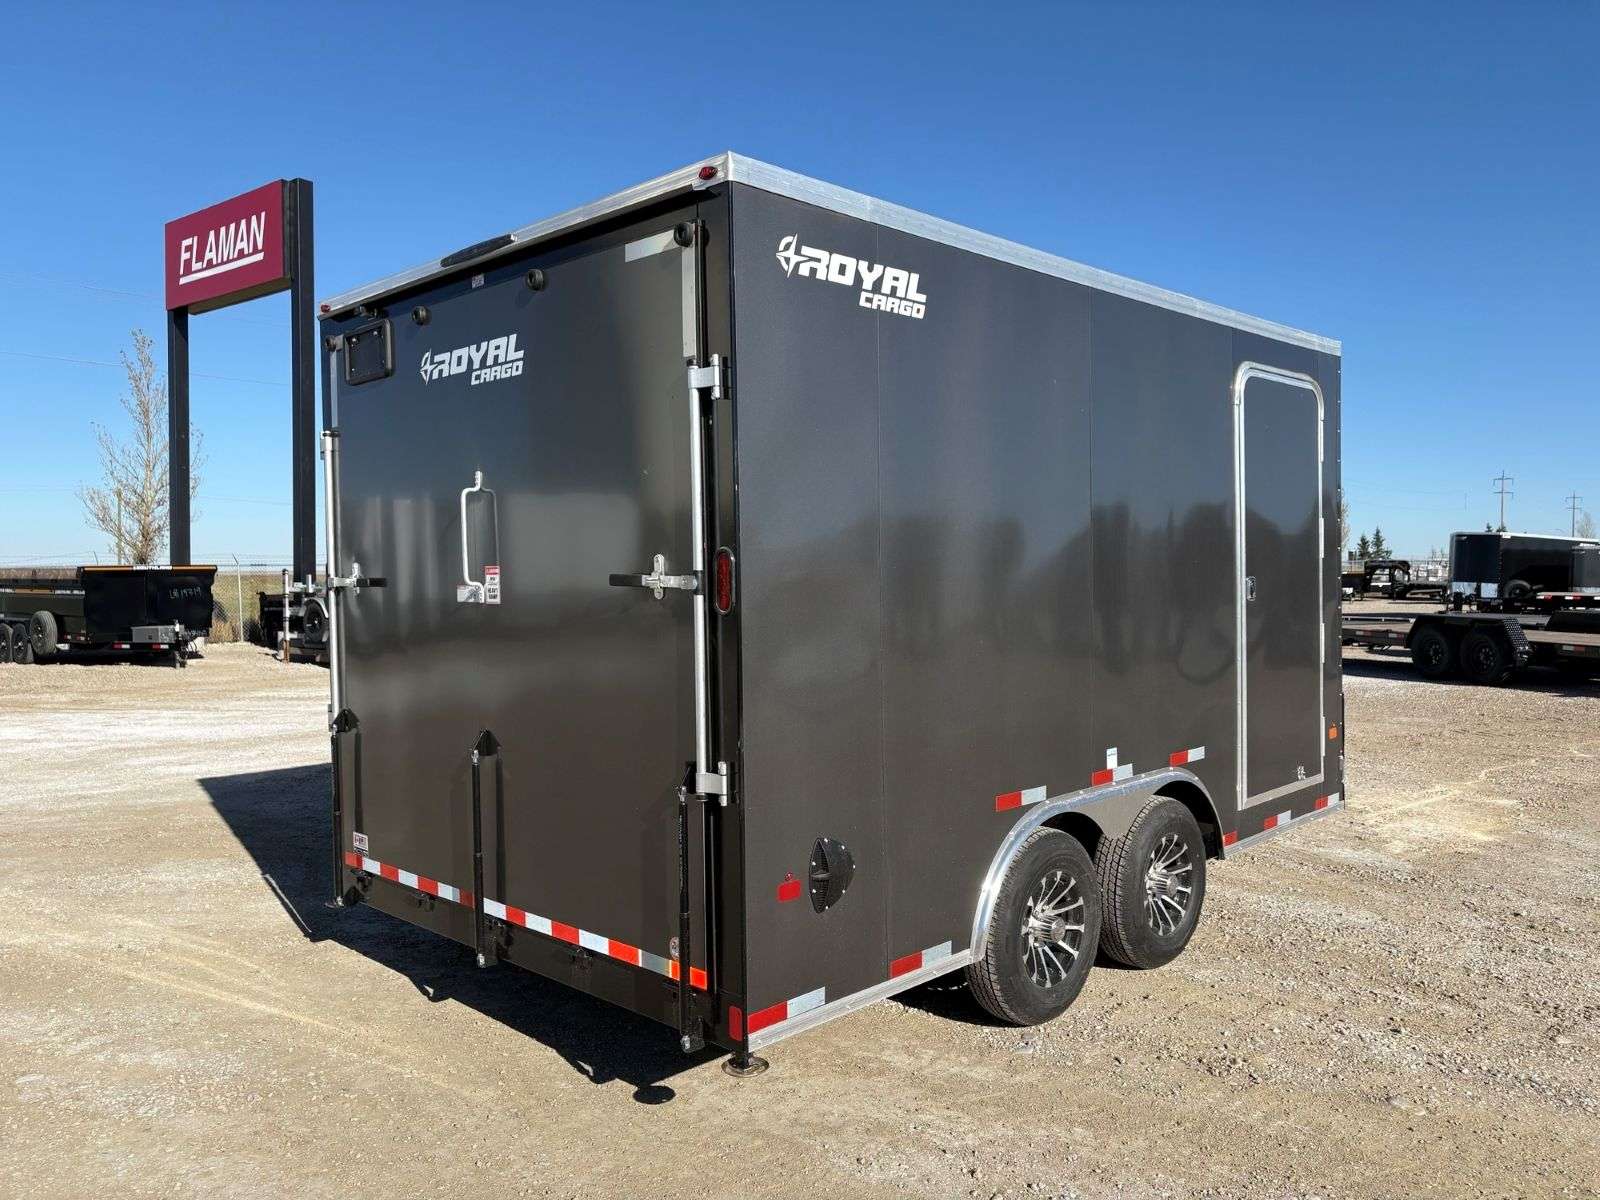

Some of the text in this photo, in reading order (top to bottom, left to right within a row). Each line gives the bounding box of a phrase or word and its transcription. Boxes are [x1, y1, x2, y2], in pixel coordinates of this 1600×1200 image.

[180, 210, 266, 276] FLAMAN
[798, 245, 928, 303] ROYAL
[858, 290, 926, 320] CARGO
[431, 333, 525, 380] ROYAL
[470, 360, 524, 386] CARGO
